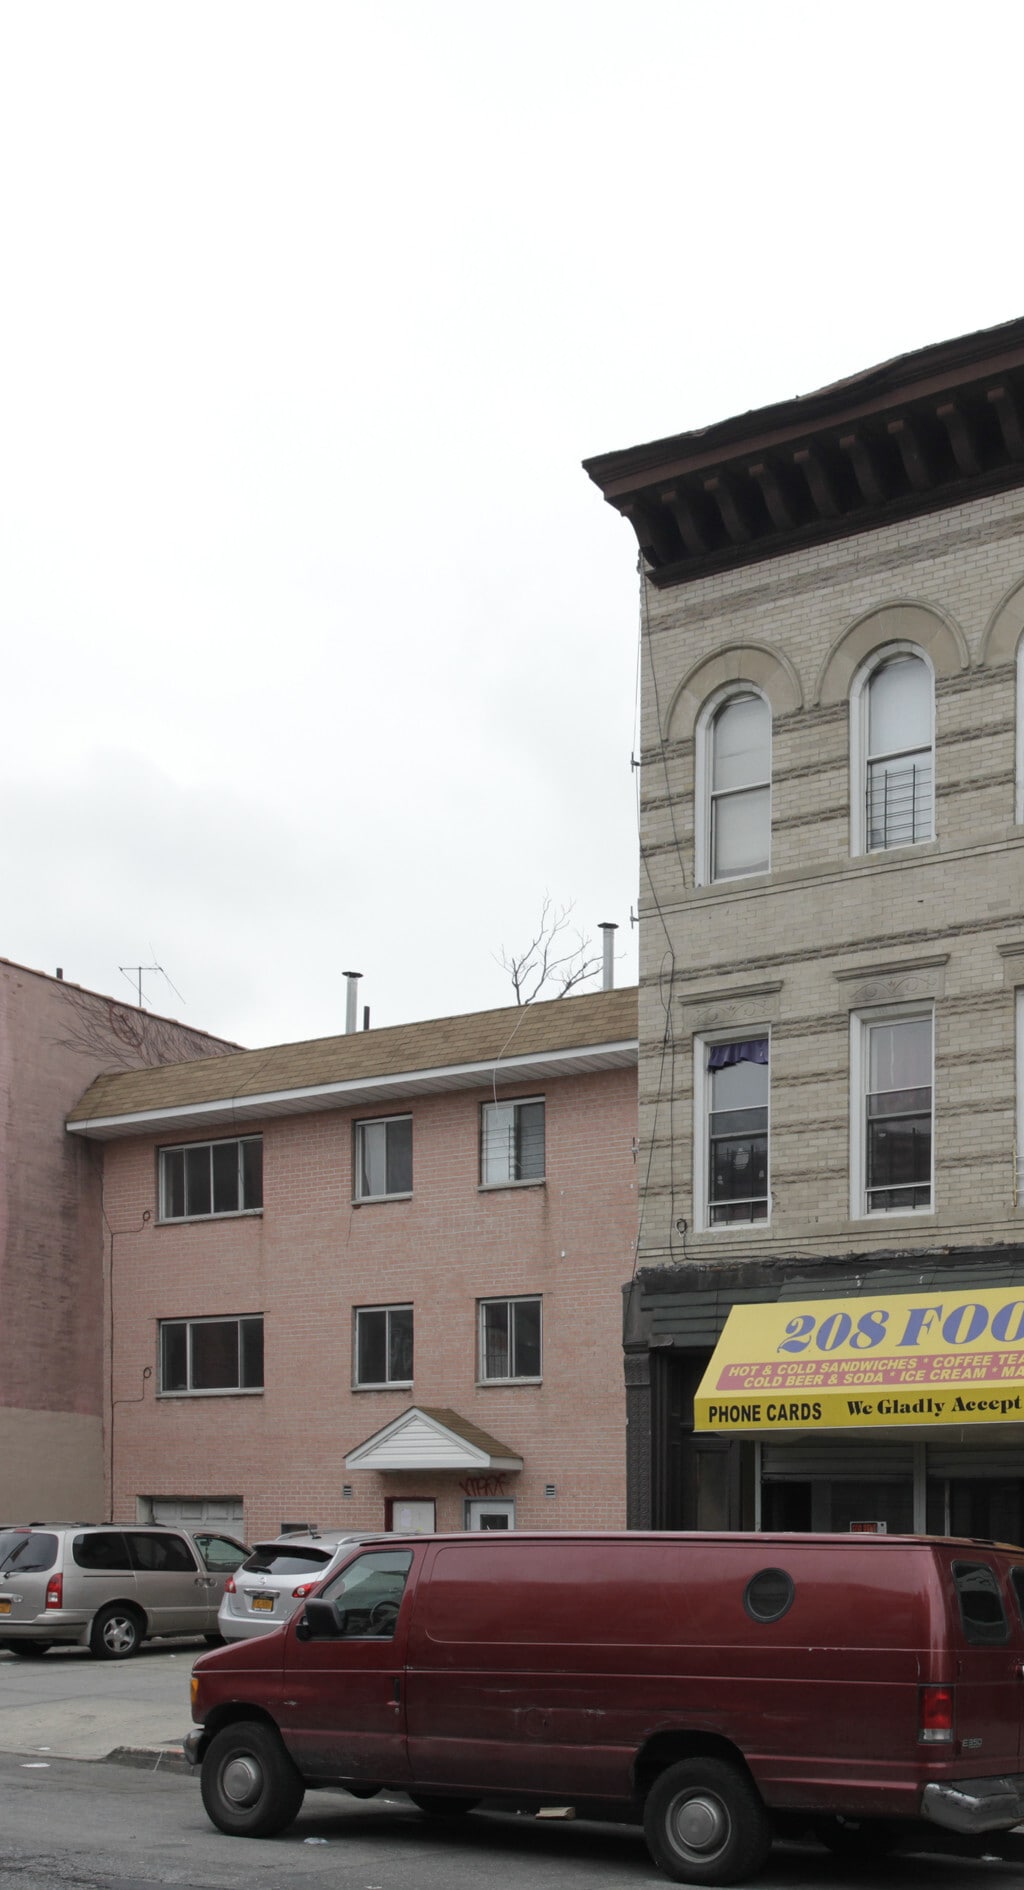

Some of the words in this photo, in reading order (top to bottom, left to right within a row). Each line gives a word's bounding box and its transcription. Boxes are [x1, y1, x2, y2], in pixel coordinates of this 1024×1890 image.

[776, 1310, 890, 1353] 208
[729, 1363, 761, 1377] HOT
[762, 1363, 775, 1376] &
[776, 1362, 817, 1375] COLD
[820, 1357, 917, 1373] SANDWICHES
[932, 1354, 993, 1369] COFFEE
[743, 1376, 782, 1389] COLD
[784, 1374, 824, 1388] BEER
[827, 1374, 840, 1386] &
[842, 1371, 885, 1385] SODA
[899, 1369, 926, 1382] ICE
[929, 1366, 988, 1381] CREAM
[708, 1404, 761, 1423] PHONE
[766, 1402, 823, 1422] CARDS
[847, 1400, 873, 1416] We
[876, 1398, 945, 1417] Gladly
[951, 1393, 1022, 1414] Accept
